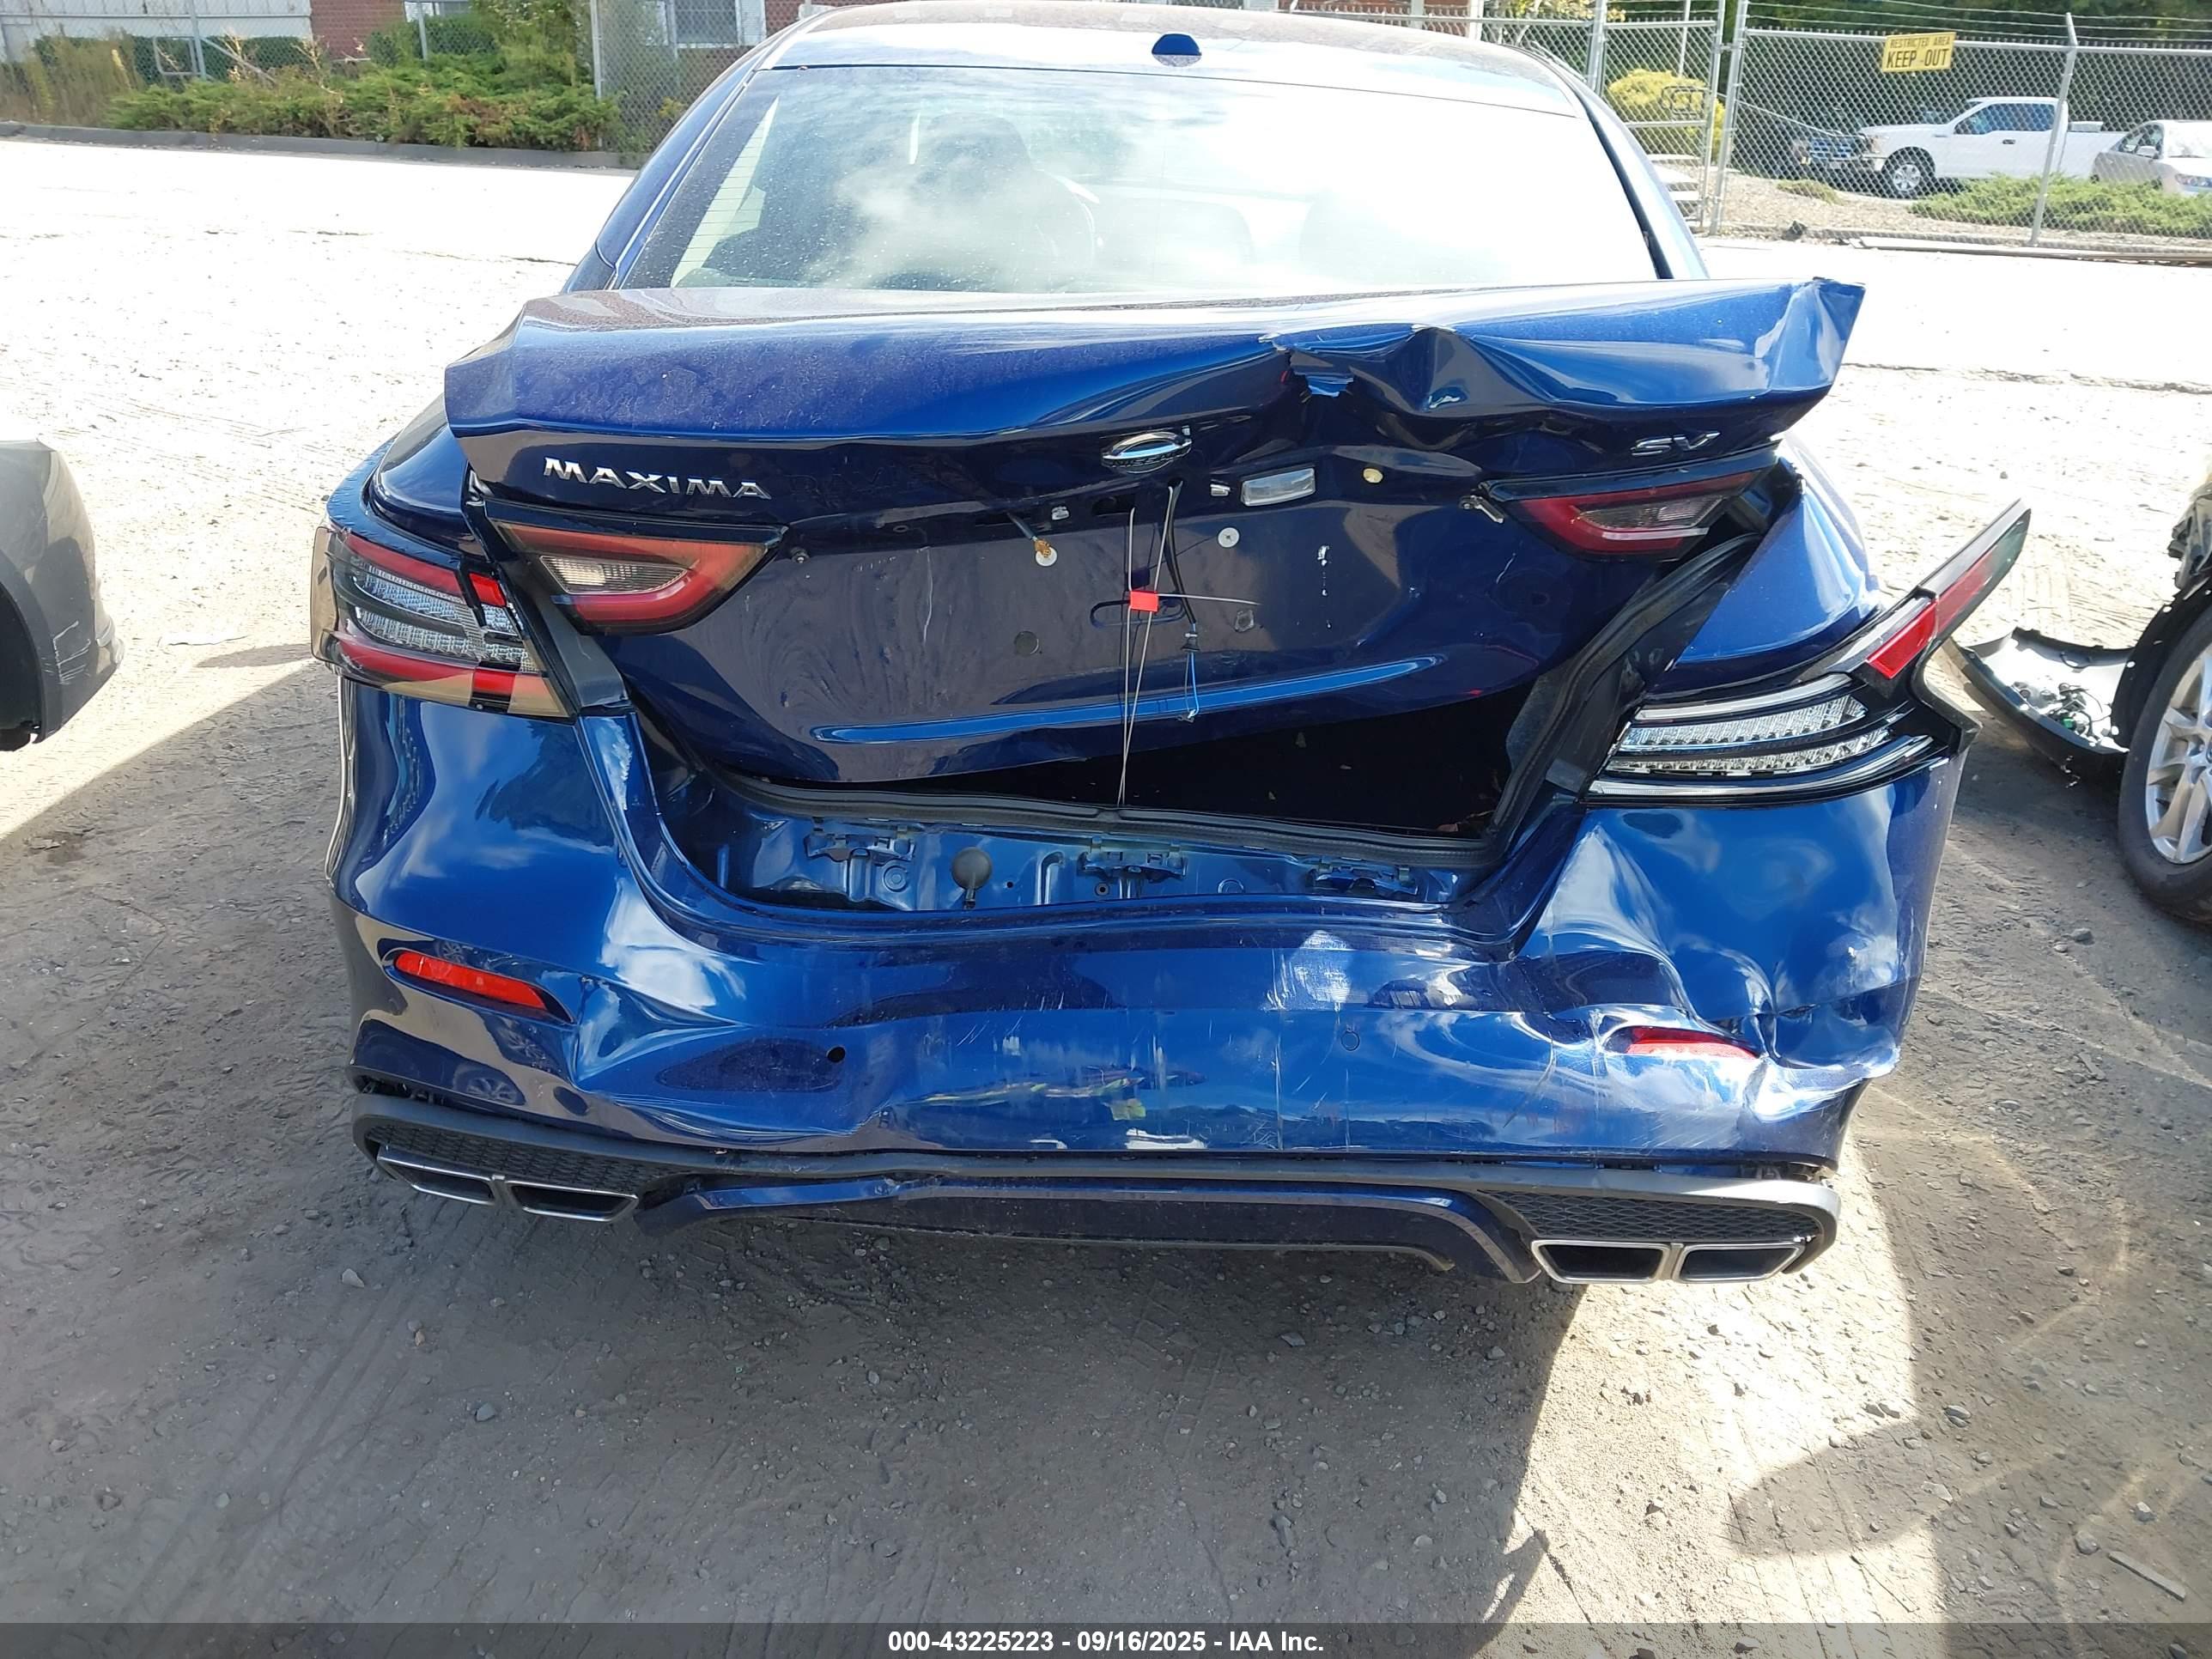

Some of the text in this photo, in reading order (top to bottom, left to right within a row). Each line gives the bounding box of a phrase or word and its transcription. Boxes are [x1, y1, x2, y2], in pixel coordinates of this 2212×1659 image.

[1890, 36, 1951, 49] RESTRICTED AREA
[1887, 48, 1949, 69] KEEP OUT
[1631, 431, 1721, 456] SV
[544, 457, 772, 500] MAXIMA
